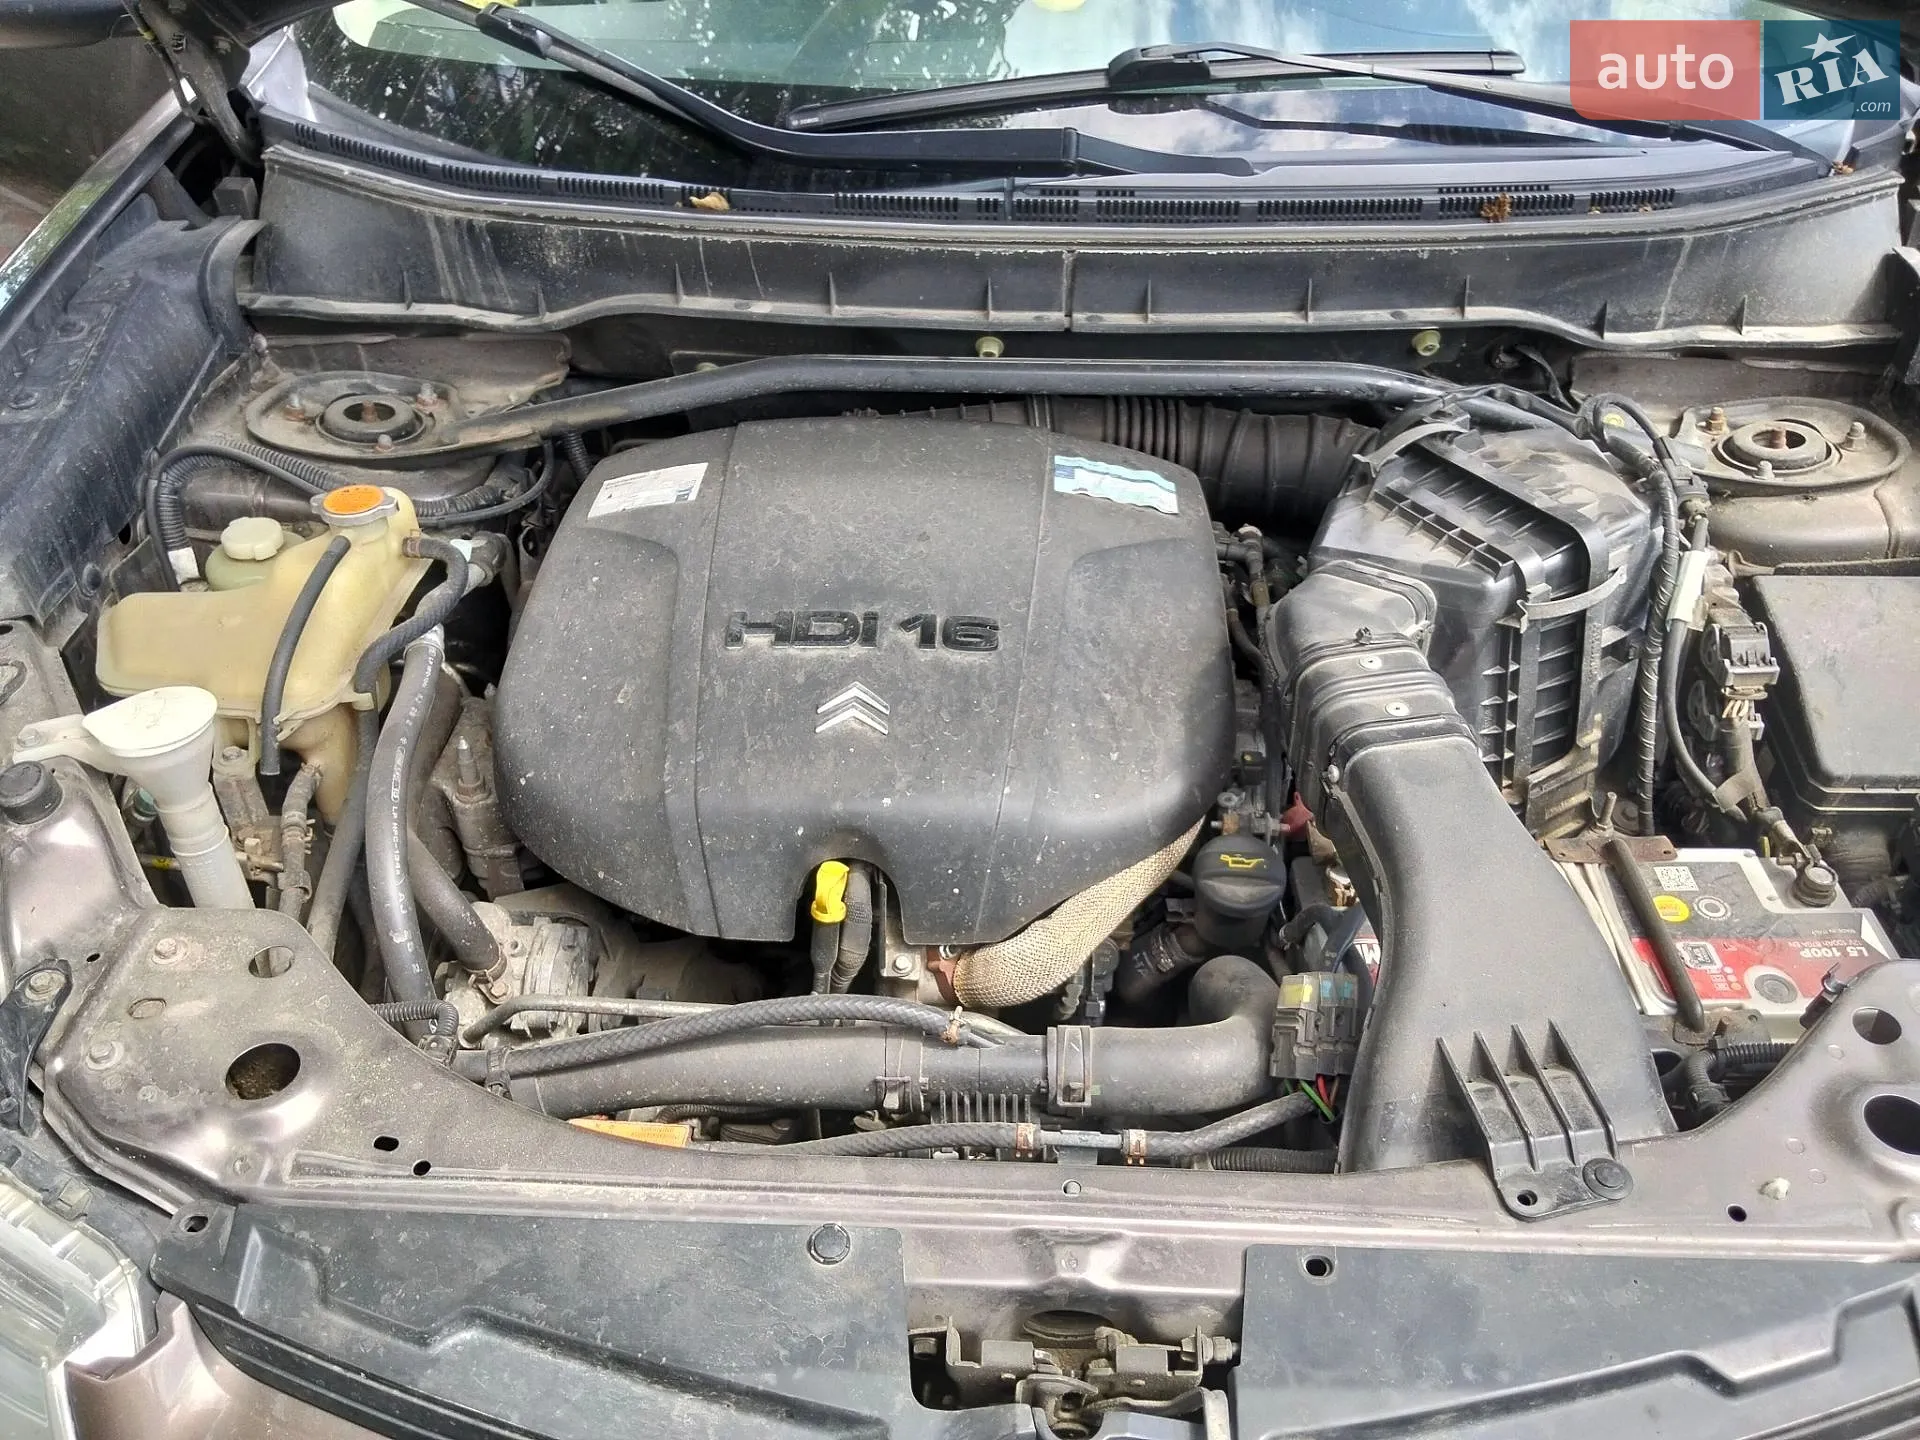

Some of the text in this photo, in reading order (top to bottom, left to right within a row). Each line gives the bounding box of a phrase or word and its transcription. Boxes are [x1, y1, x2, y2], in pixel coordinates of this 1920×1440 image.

[900, 613, 1000, 653] 16
[1799, 945, 1869, 959] L5 100P
